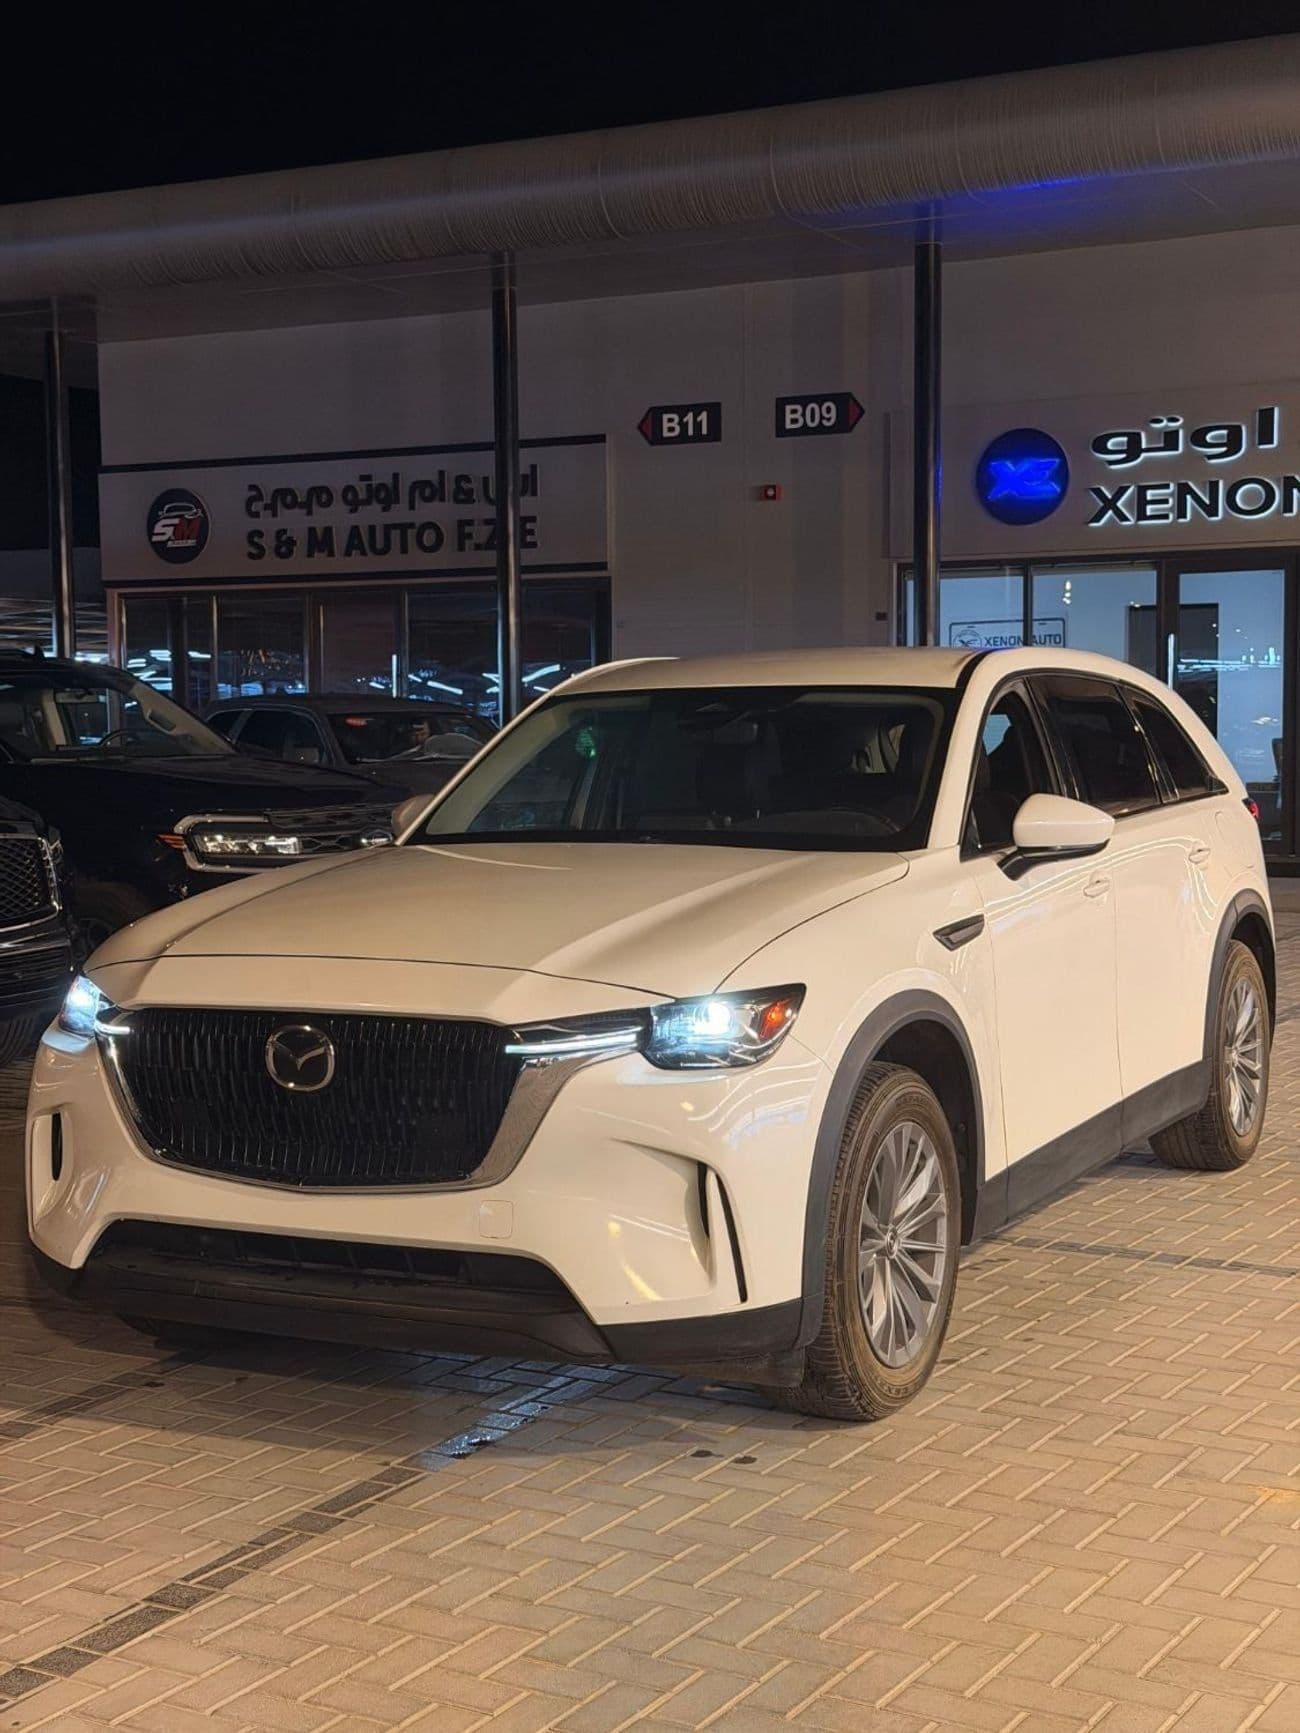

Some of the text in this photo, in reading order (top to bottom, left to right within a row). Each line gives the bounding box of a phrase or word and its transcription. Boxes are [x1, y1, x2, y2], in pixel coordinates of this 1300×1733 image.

[661, 410, 708, 438] B11
[784, 402, 837, 430] B09
[1090, 406, 1280, 470] اوتو
[247, 516, 538, 561] S & M AUTO F.ZE
